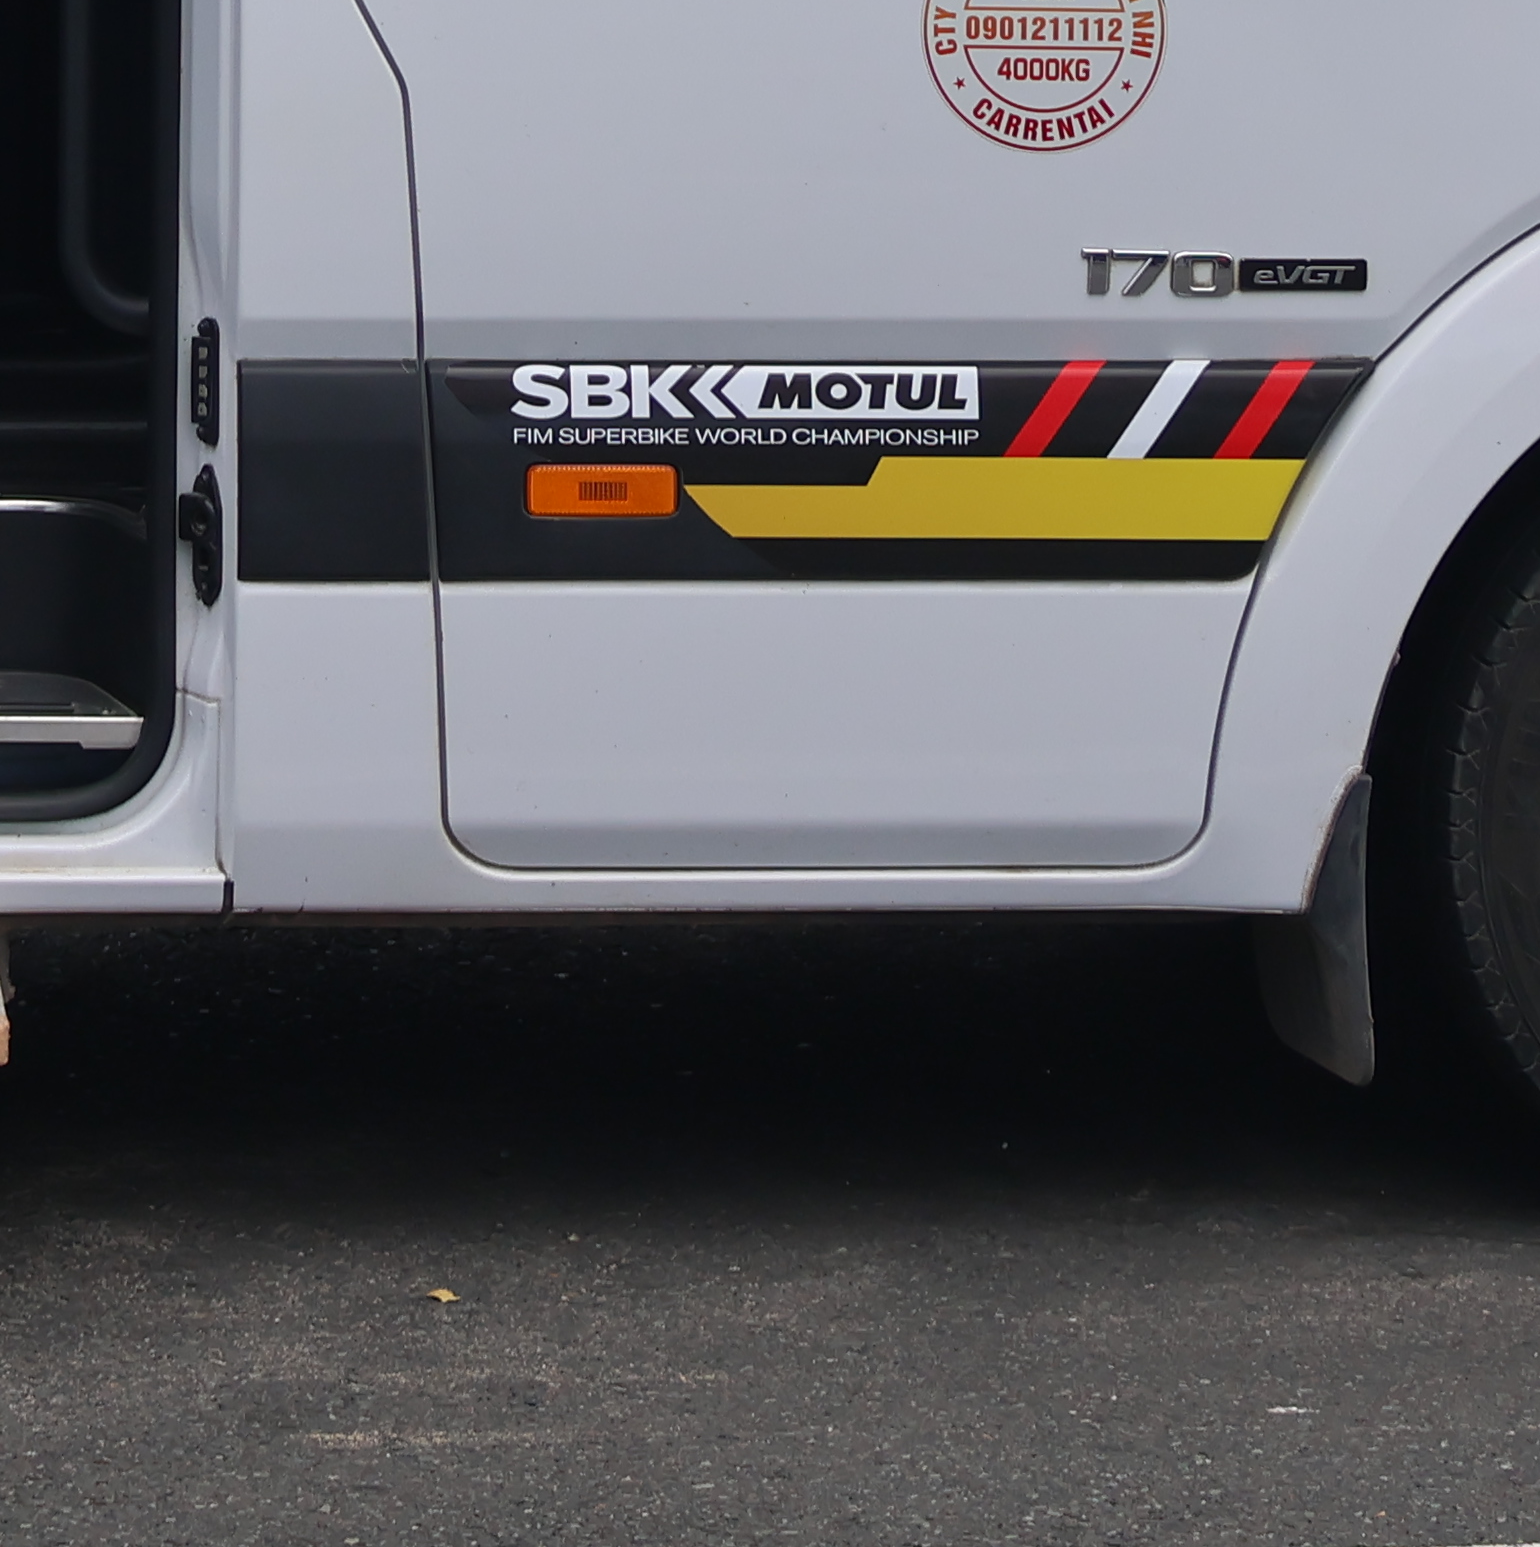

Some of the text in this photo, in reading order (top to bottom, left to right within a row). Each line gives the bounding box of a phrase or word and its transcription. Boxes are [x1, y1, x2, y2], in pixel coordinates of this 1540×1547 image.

[934, 6, 957, 56] CTY
[1130, 11, 1156, 59] NHI
[965, 15, 1123, 41] 0901211112
[998, 57, 1091, 82] 4000KG
[1081, 247, 1356, 297] 170 eVGT
[511, 364, 968, 420] SBK MOTUL
[513, 427, 980, 446] FIM SUPERBIKE WORLD CHAMPIONSHIP
